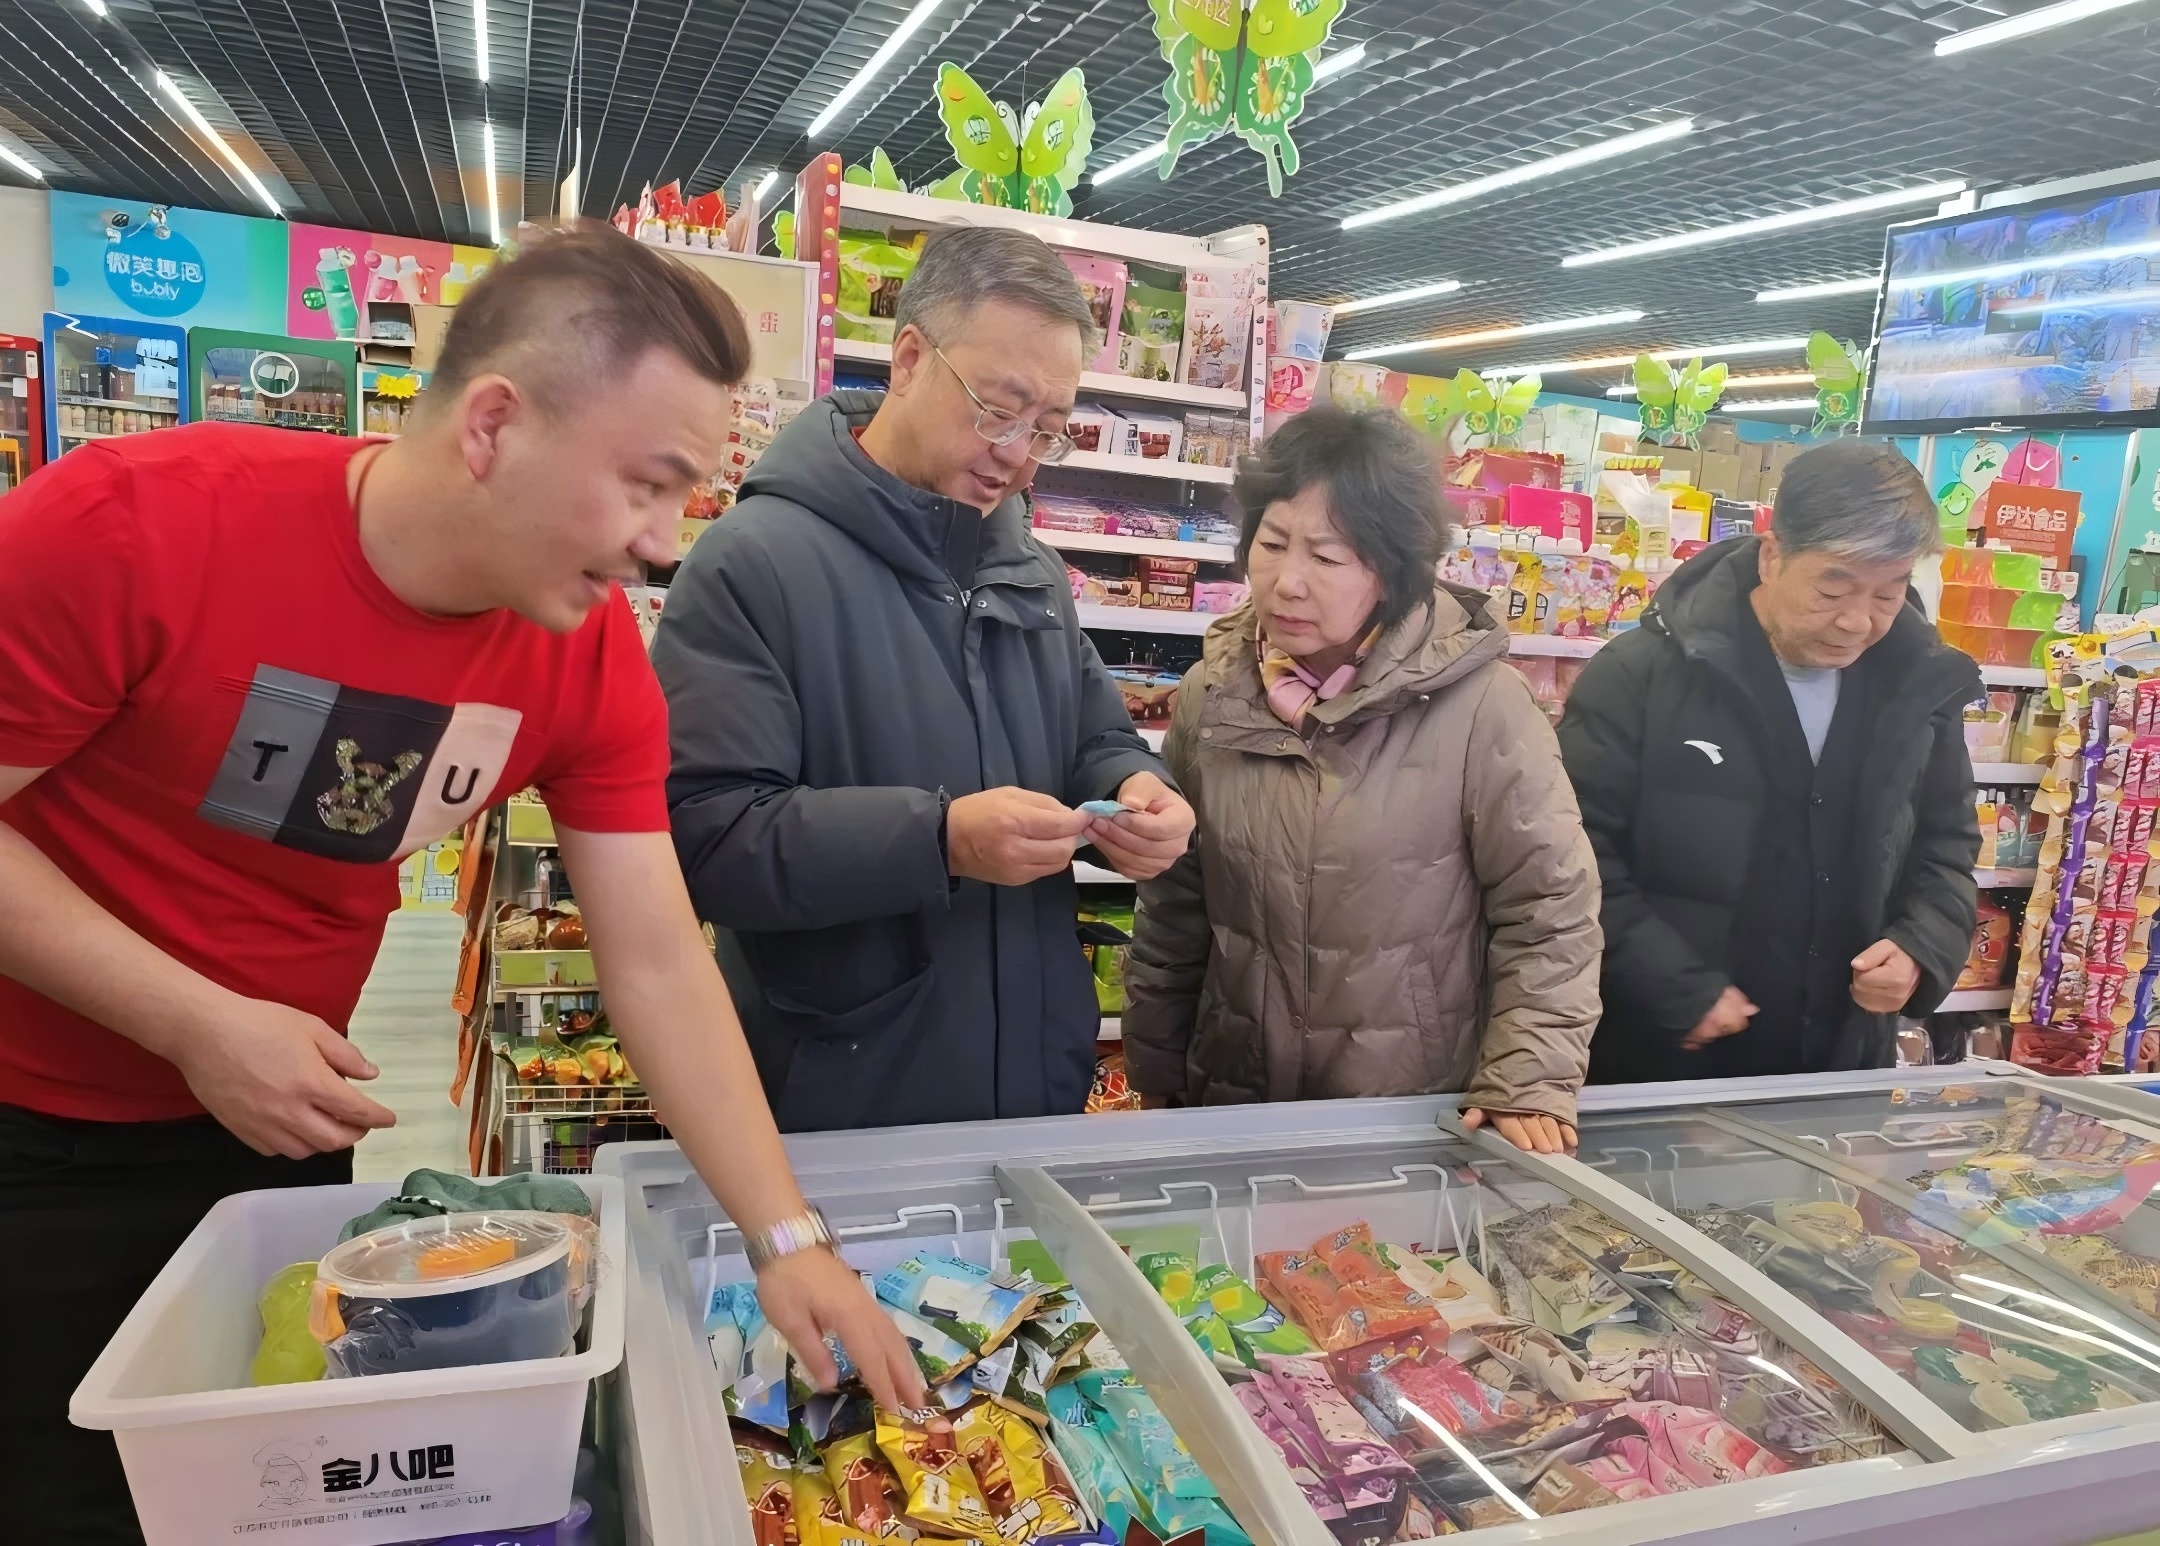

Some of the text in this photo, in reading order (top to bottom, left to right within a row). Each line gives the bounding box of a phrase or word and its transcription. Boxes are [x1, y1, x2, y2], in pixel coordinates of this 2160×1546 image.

[253, 740, 480, 805] T U
[321, 1444, 455, 1493] 金八吧
